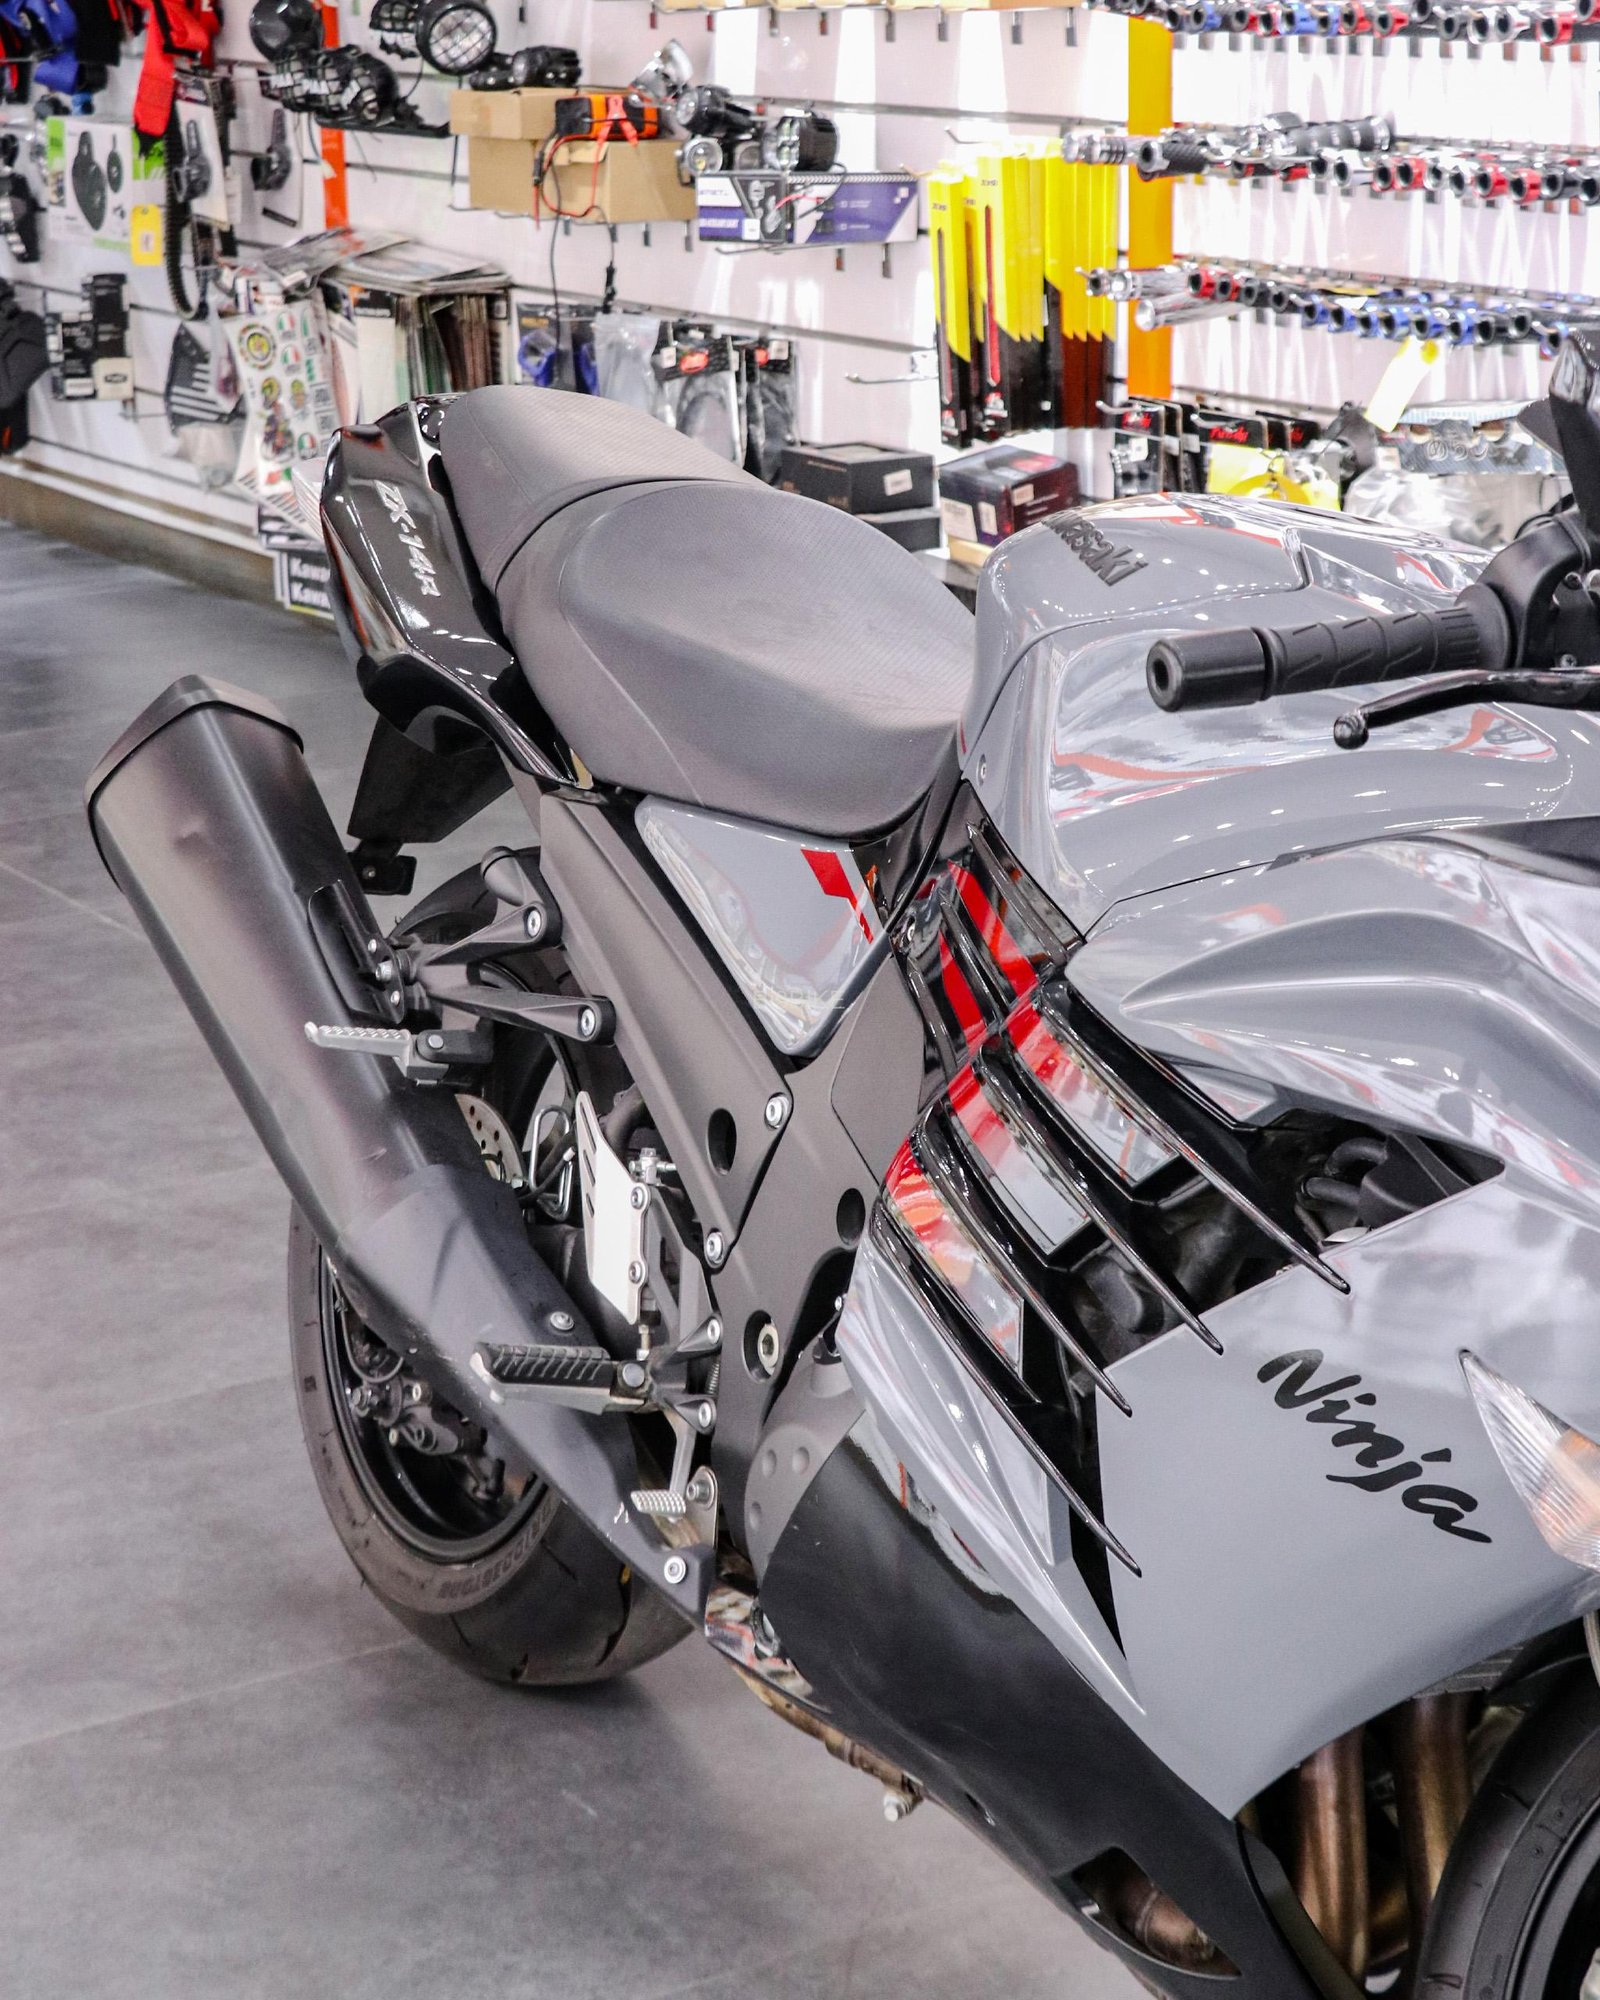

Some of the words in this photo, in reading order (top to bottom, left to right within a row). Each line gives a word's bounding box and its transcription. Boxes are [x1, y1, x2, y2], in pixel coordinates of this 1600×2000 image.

[375, 478, 441, 597] ZX-14R
[1042, 509, 1149, 587] wasaki
[1256, 1348, 1493, 1544] Ninja
